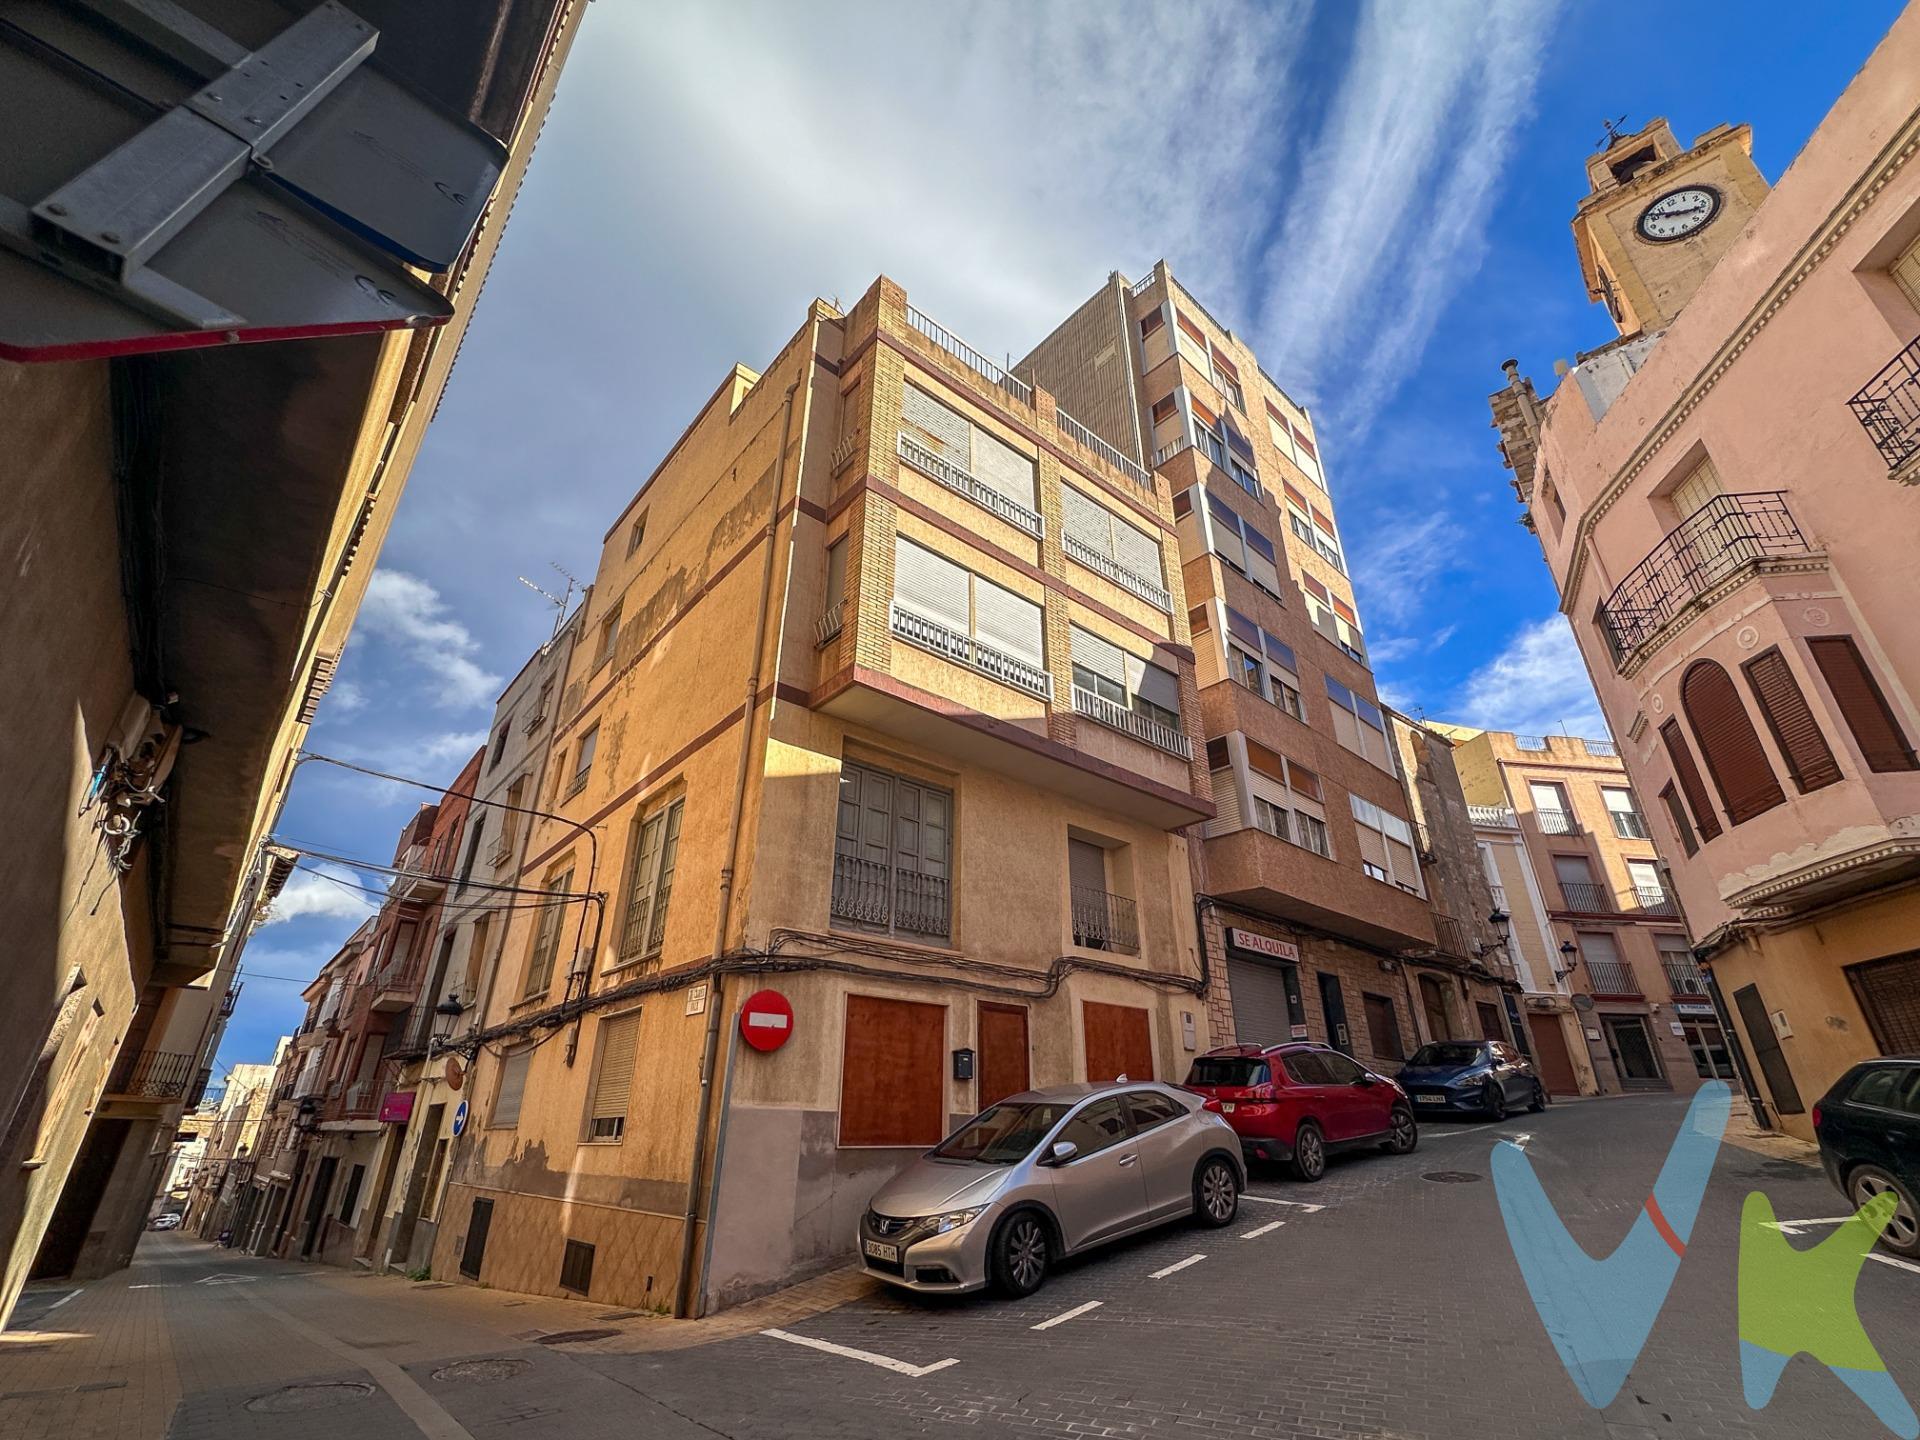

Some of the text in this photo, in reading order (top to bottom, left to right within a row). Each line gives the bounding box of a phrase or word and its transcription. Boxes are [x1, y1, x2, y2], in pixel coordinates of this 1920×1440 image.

[1667, 199, 1677, 207] 12
[355, 275, 397, 305] CE
[1238, 933, 1295, 957] SE ALQUILA
[882, 1245, 896, 1260] HTH
